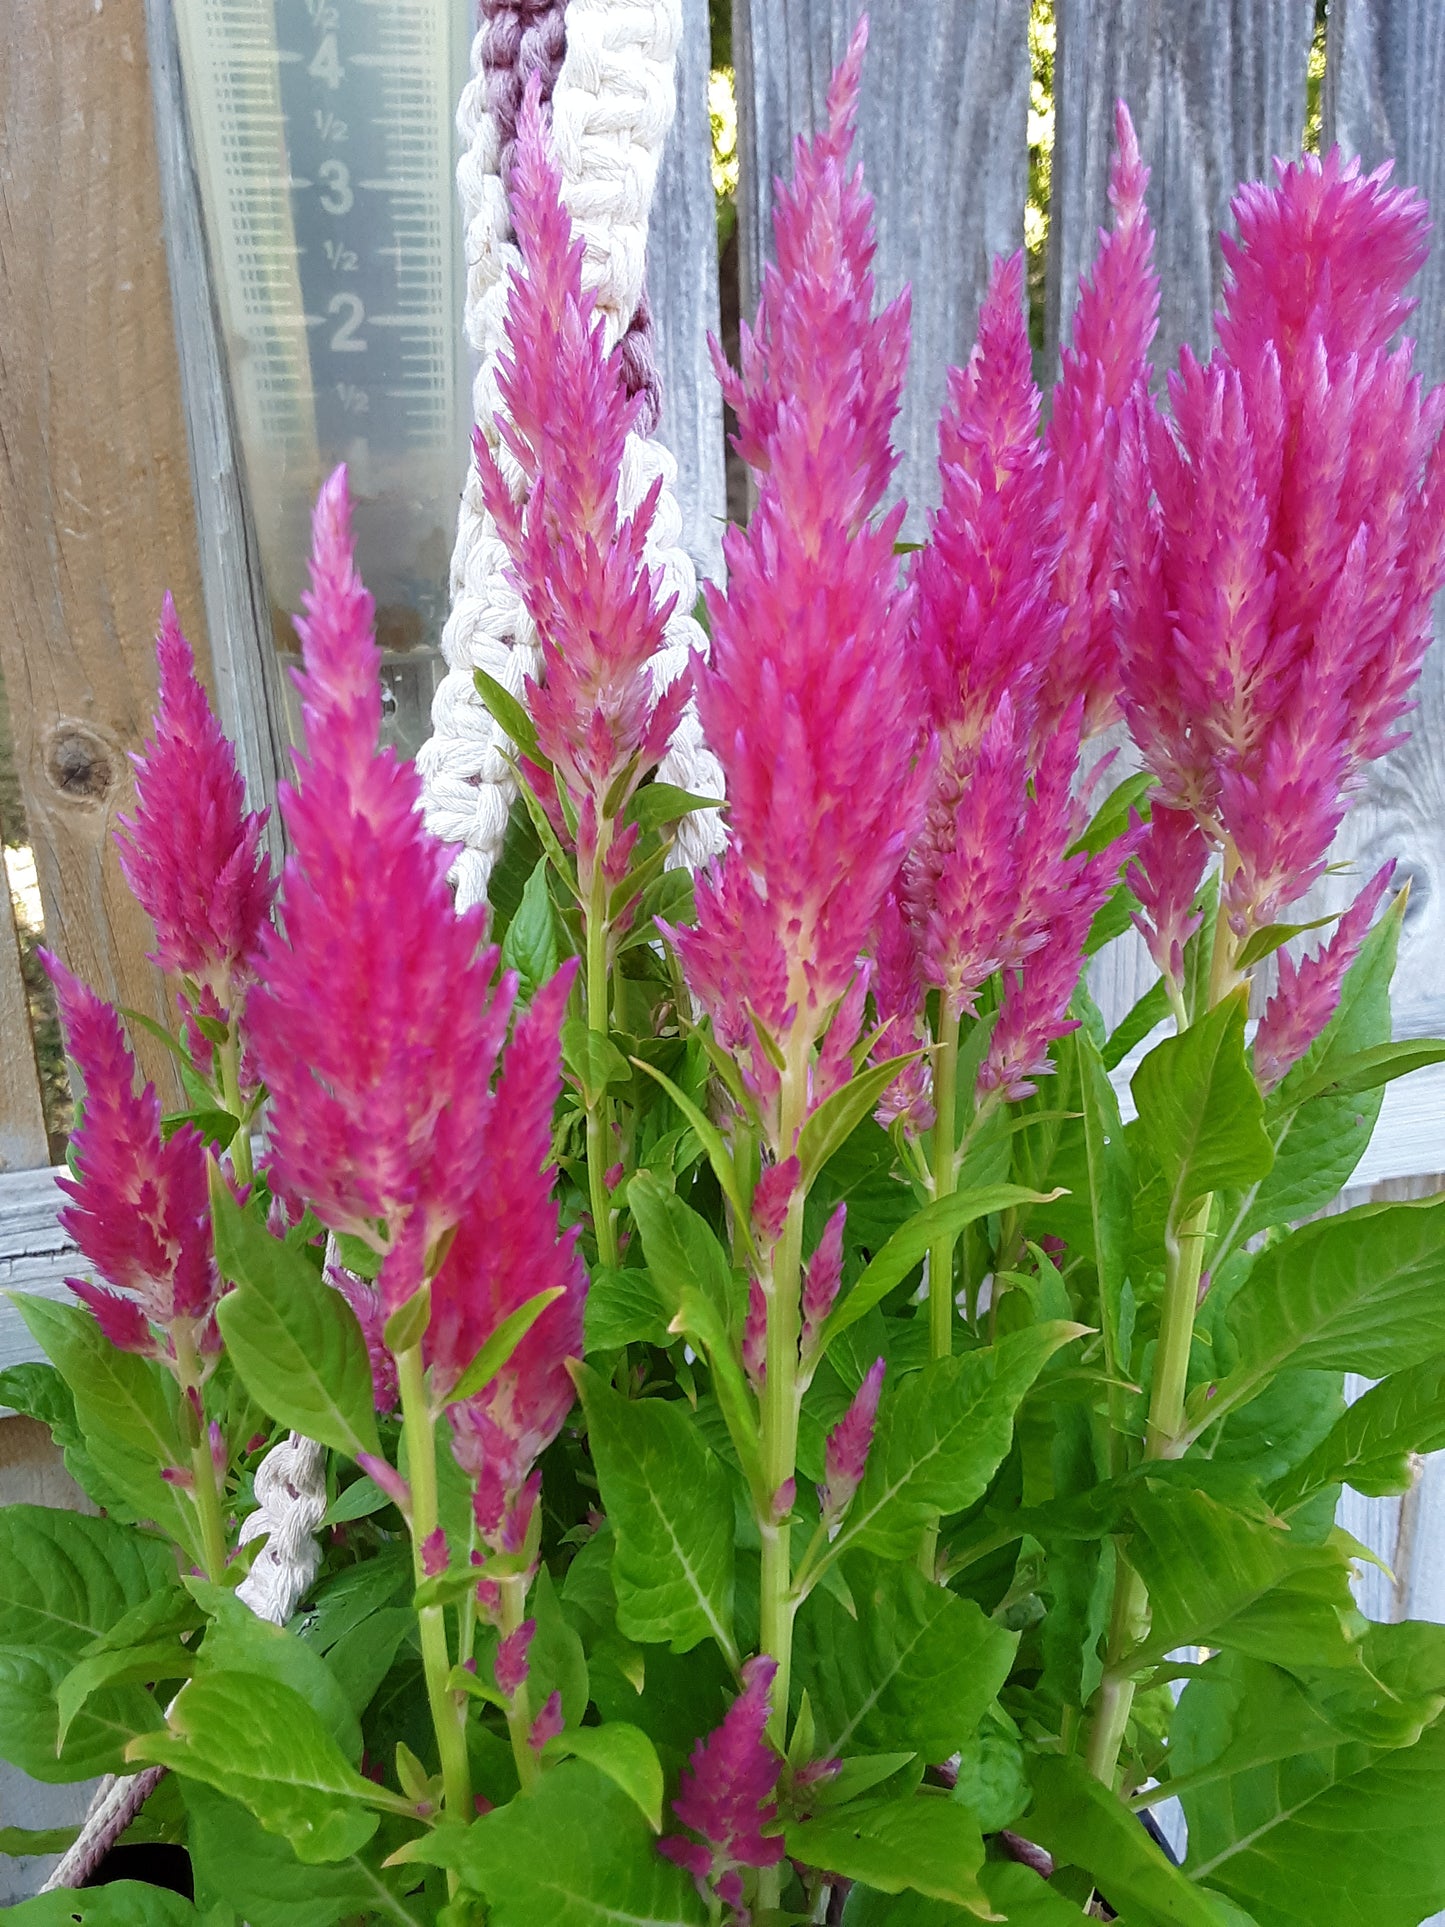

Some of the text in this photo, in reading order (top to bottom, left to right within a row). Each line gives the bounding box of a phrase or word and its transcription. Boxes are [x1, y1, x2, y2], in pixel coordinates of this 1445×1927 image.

[308, 33, 345, 89] 4
[319, 159, 354, 215] 3
[327, 293, 367, 352] 2
